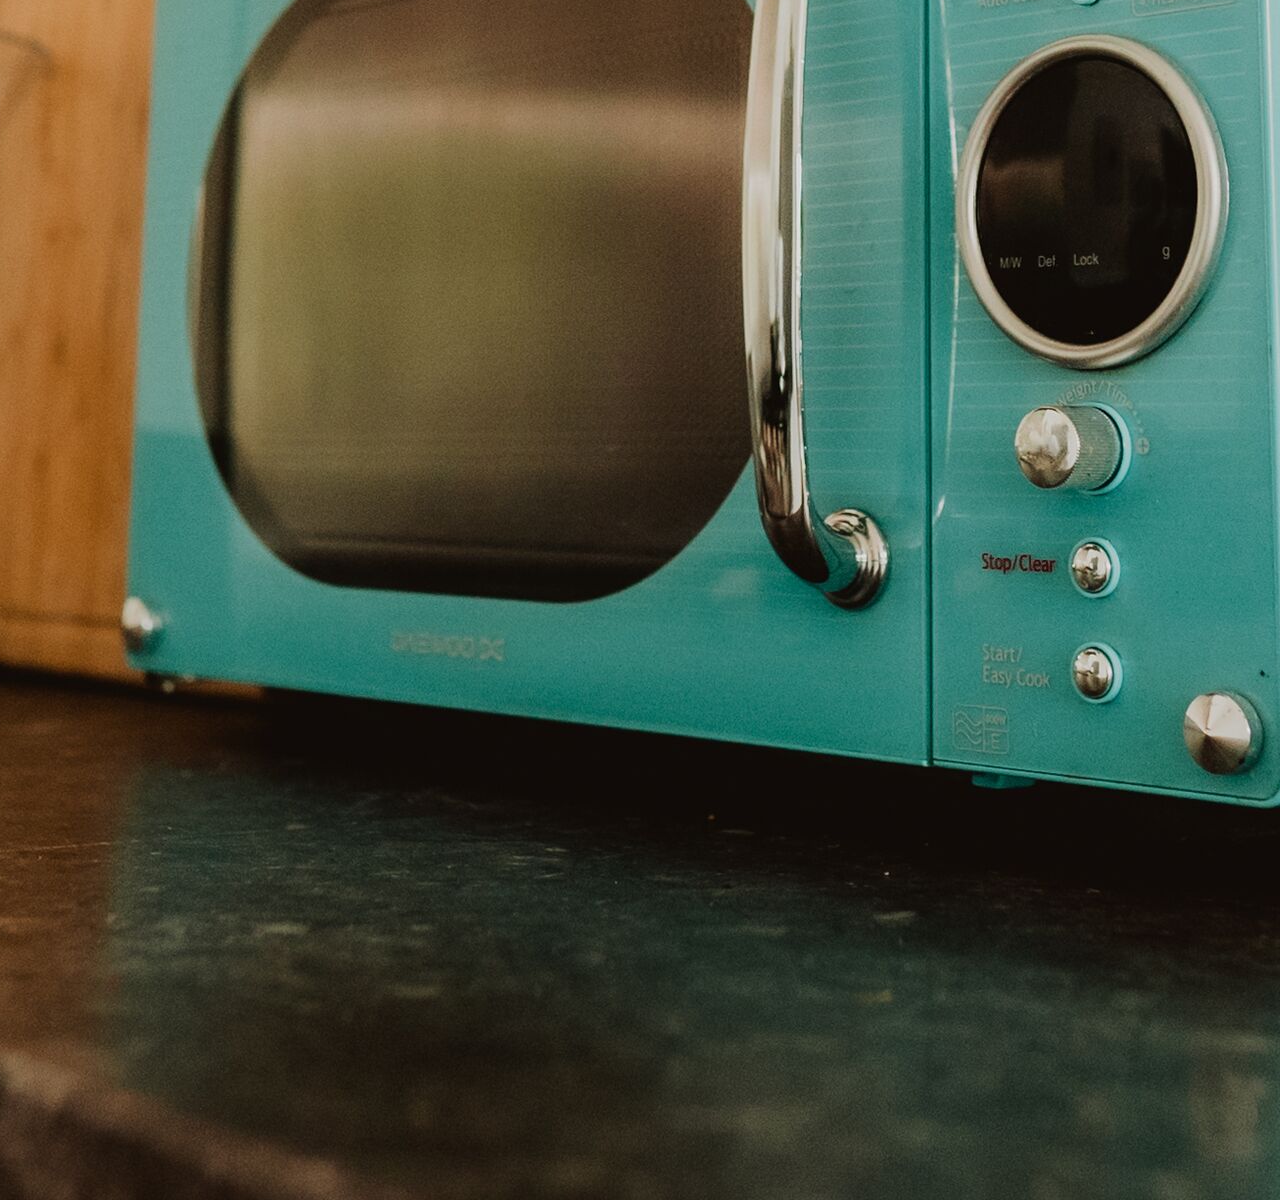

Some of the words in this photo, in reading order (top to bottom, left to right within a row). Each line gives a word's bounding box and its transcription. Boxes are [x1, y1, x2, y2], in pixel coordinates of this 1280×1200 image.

[1073, 253, 1099, 266] Lock
[1161, 246, 1170, 259] g
[982, 553, 1056, 574] Stop/Clear
[982, 643, 1022, 663] Start/
[982, 665, 1012, 688] Easy
[1015, 668, 1051, 689] Cook
